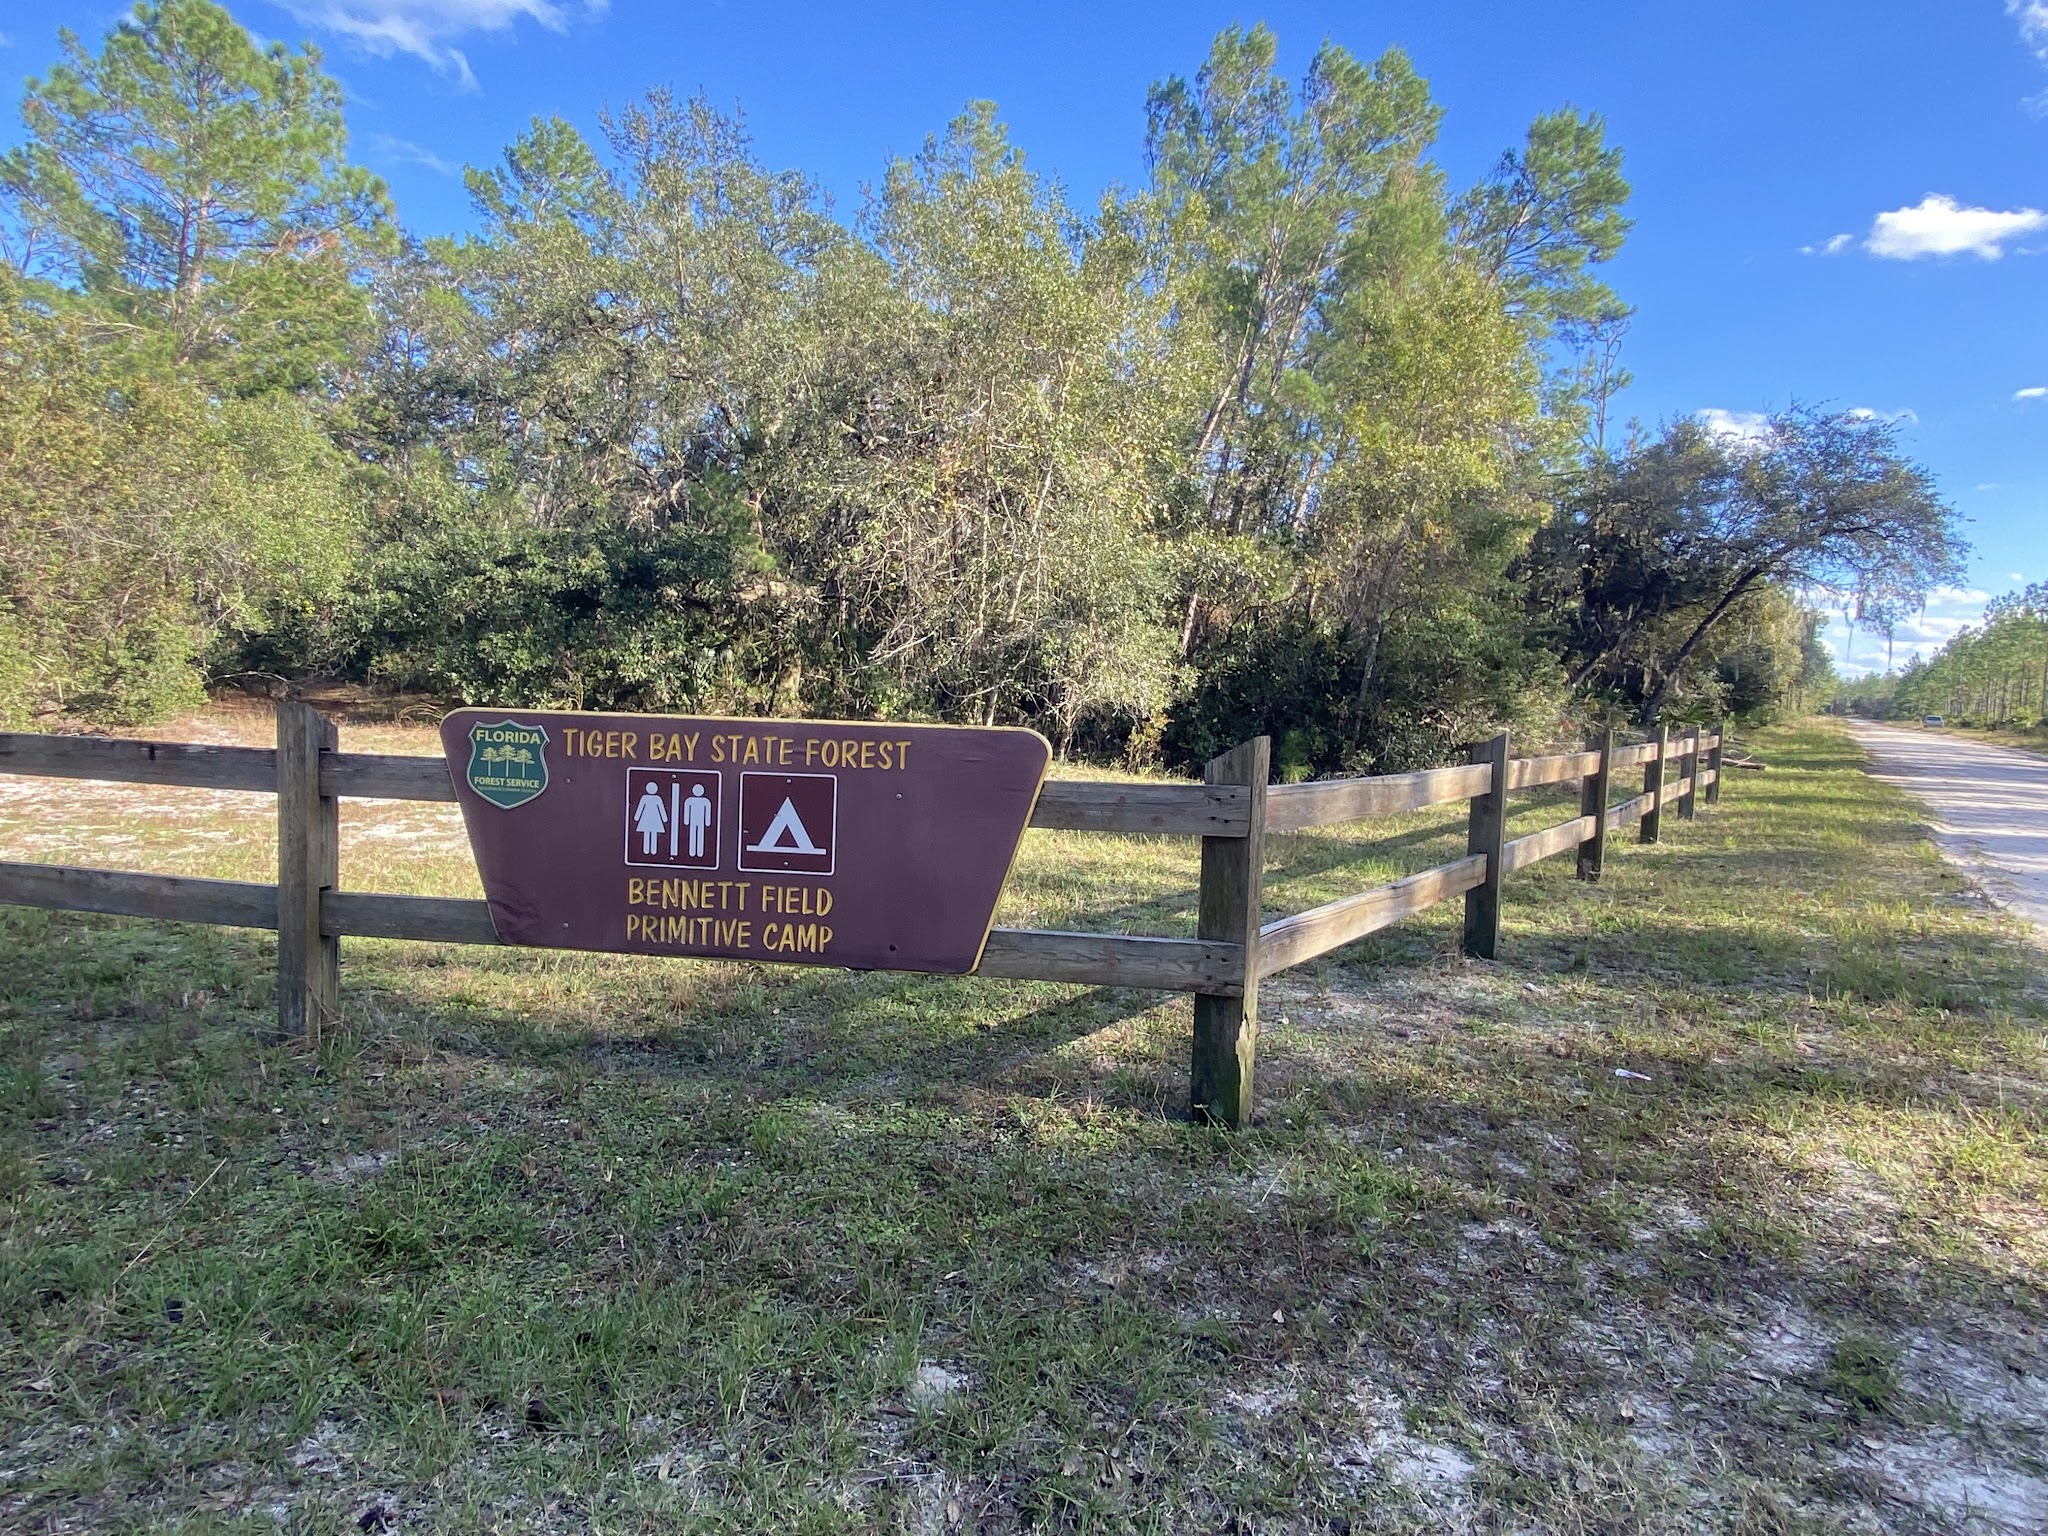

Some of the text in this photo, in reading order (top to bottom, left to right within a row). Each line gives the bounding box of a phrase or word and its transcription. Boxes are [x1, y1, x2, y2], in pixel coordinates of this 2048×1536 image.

[476, 729, 541, 744] FLORIDA
[562, 728, 911, 770] TIGER BAY STATE FOREST
[474, 776, 540, 788] FOREST SERVICE
[628, 877, 833, 917] BENNETT FIELD
[626, 914, 834, 954] PRIMITIVE CAMP
